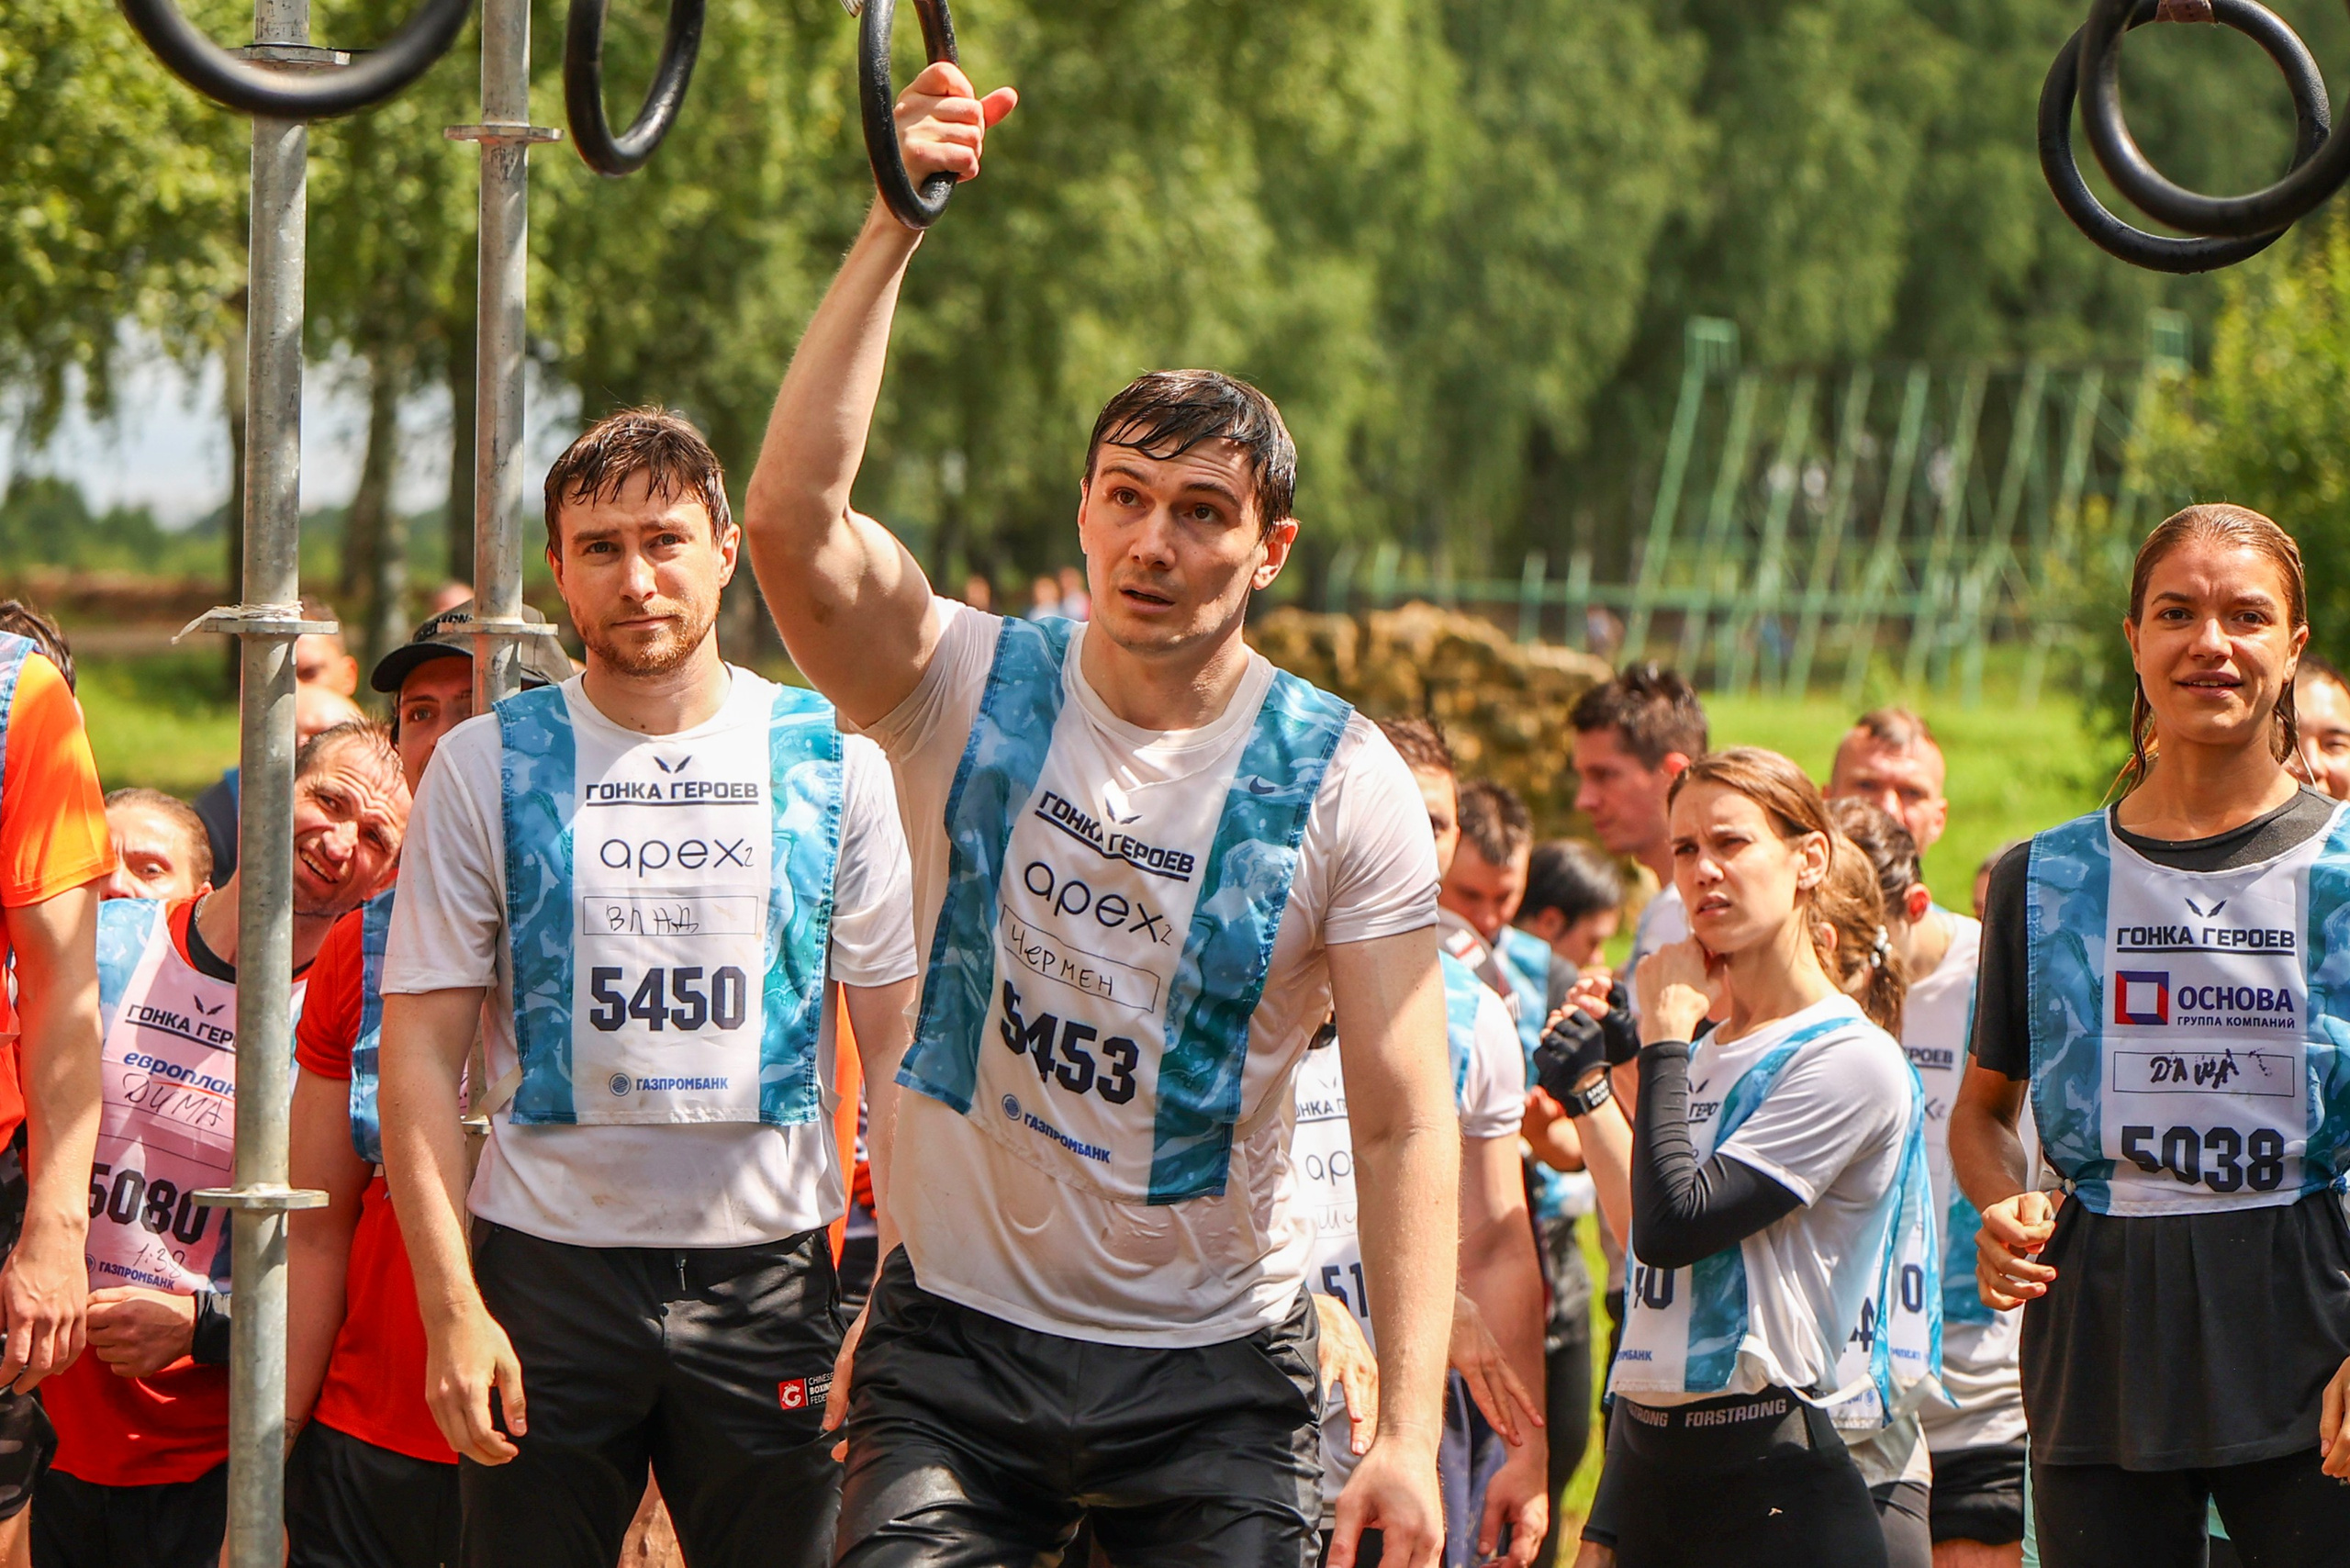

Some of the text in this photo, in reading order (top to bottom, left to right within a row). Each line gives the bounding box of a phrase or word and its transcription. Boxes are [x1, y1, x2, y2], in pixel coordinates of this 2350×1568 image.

[587, 781, 758, 800] ГОНКА ГЕРОЕВ
[599, 837, 744, 878] apex
[1107, 833, 1195, 874] ГЕРОЕВ
[1024, 860, 1165, 944] apex
[2117, 926, 2295, 947] ГОНКА ГЕРОЕВ
[589, 965, 746, 1032] 5450
[2177, 985, 2294, 1013] ОСНОВА
[128, 1004, 236, 1048] ГОНКА ГЕР
[2177, 1016, 2295, 1029] ГРУППА КОМПАНИЙ
[1001, 980, 1139, 1104] 5453
[636, 1076, 729, 1091] ГАЗПРОМБАНК
[1295, 1099, 1334, 1117] НКА
[1689, 1102, 1721, 1117] ГЕРО
[1024, 1113, 1111, 1164] ГАЗПРОМБАНК
[1305, 1150, 1351, 1186] ap
[2121, 1126, 2284, 1193] 5038
[89, 1162, 210, 1245] 5080
[98, 1261, 176, 1290] ГАЗПРОМБАНК
[1321, 1262, 1369, 1317] 51
[1684, 1398, 1787, 1428] FORSTRONG
